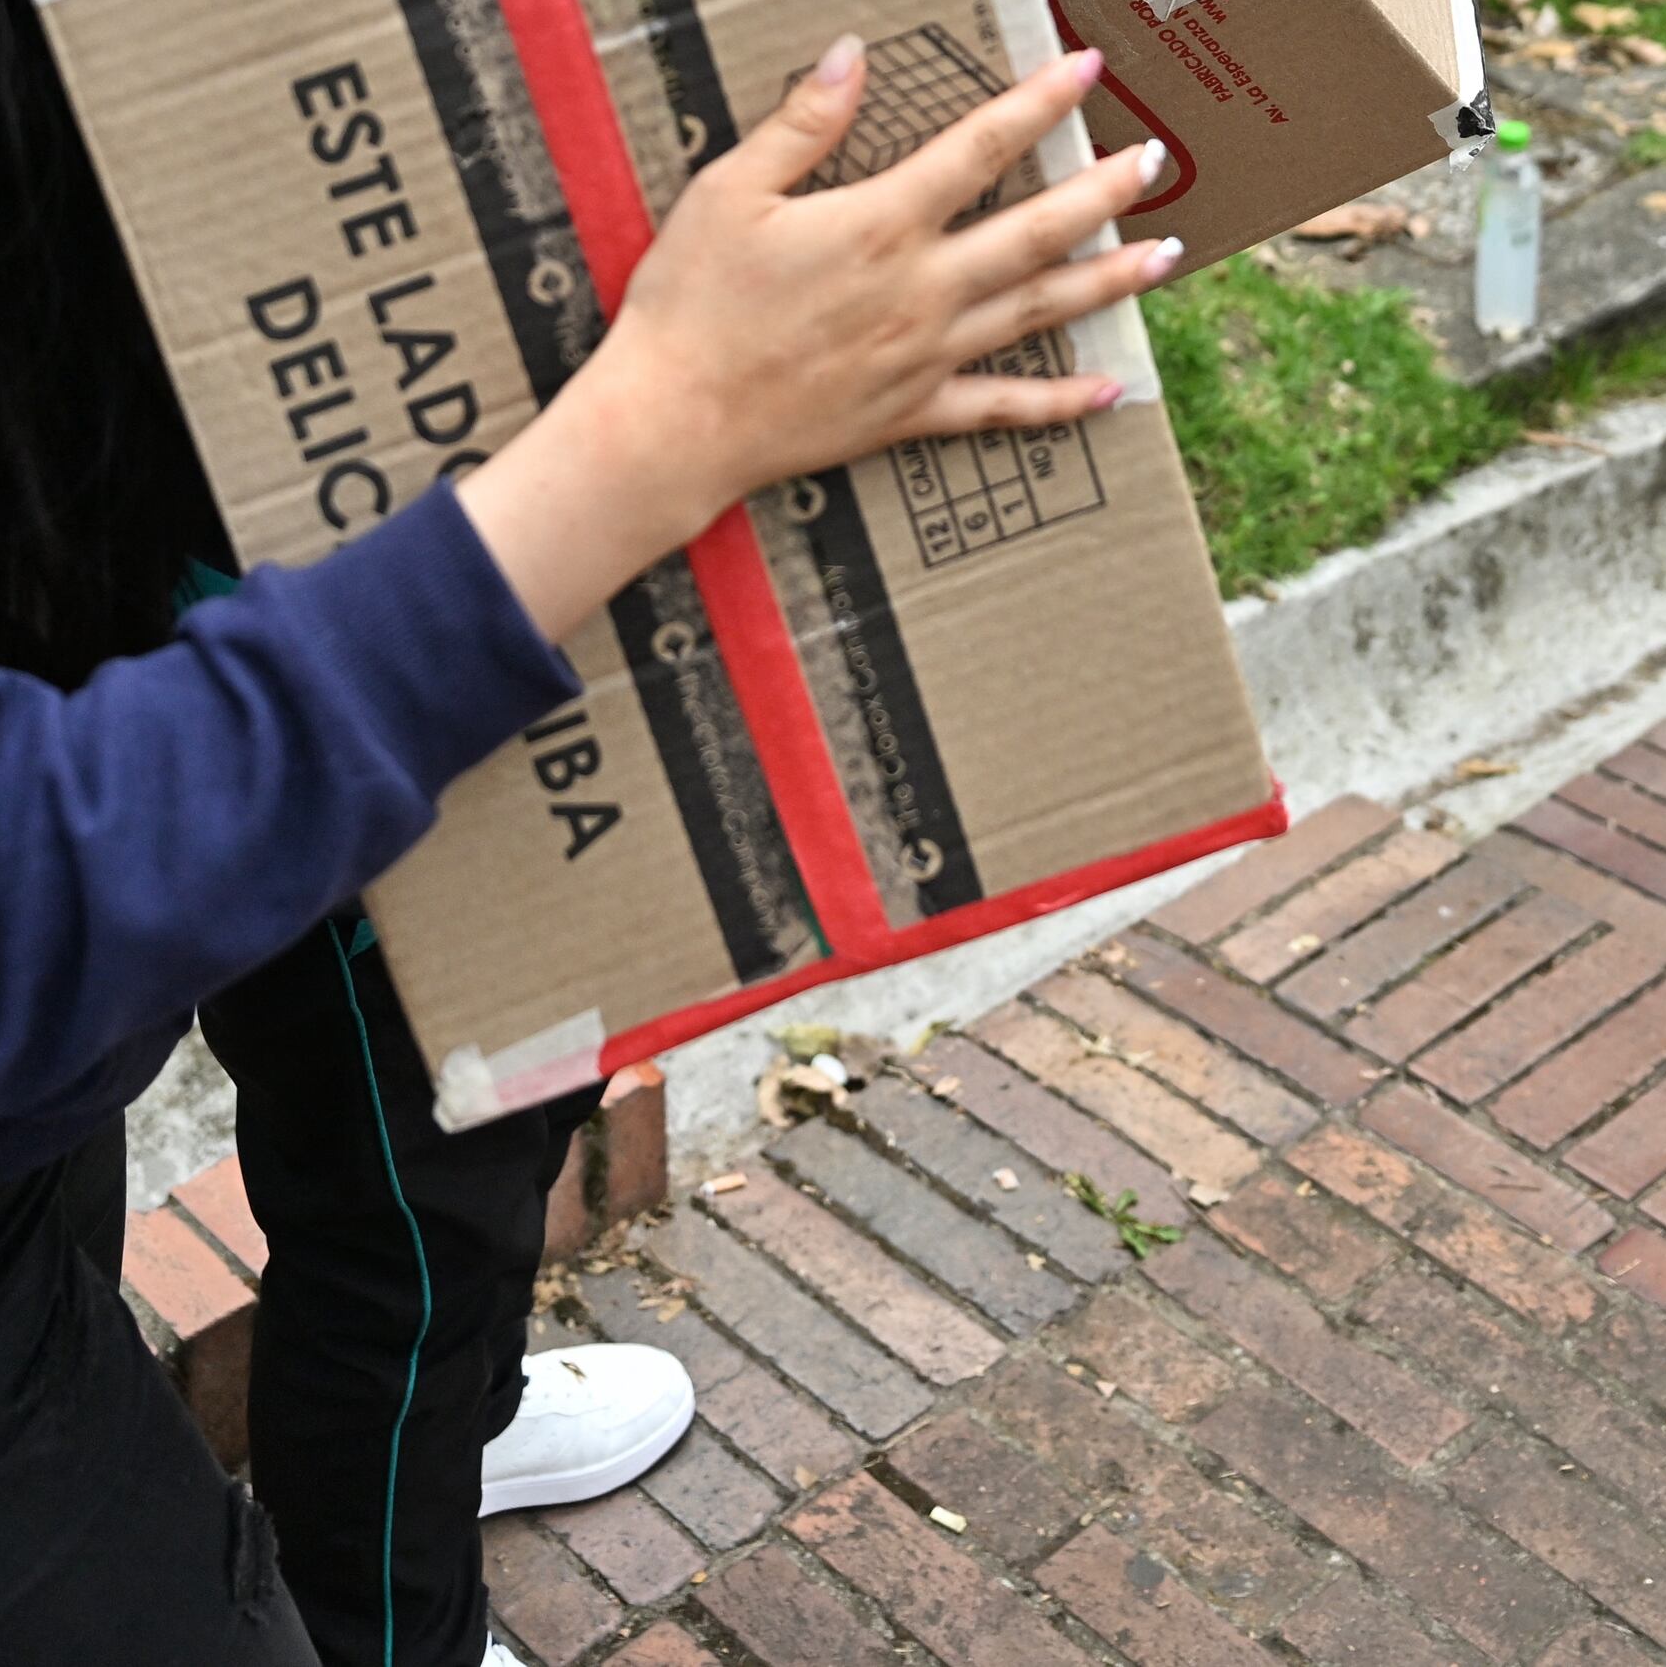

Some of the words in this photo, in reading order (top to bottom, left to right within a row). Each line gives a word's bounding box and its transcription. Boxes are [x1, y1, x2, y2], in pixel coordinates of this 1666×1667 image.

[1131, 0, 1164, 29] POR
[1160, 31, 1234, 103] FABRICADO
[1185, 20, 1252, 88] Esperanza
[1248, 87, 1269, 106] La
[1264, 104, 1290, 125] Av.
[290, 60, 419, 260] ESTE
[245, 275, 392, 532] DELIC
[1028, 444, 1057, 480] NO
[963, 510, 990, 533] 6
[1002, 498, 1025, 516] 1
[925, 518, 955, 554] 12
[818, 557, 880, 696] Company
[859, 692, 909, 783] Clorox
[886, 781, 925, 832] The
